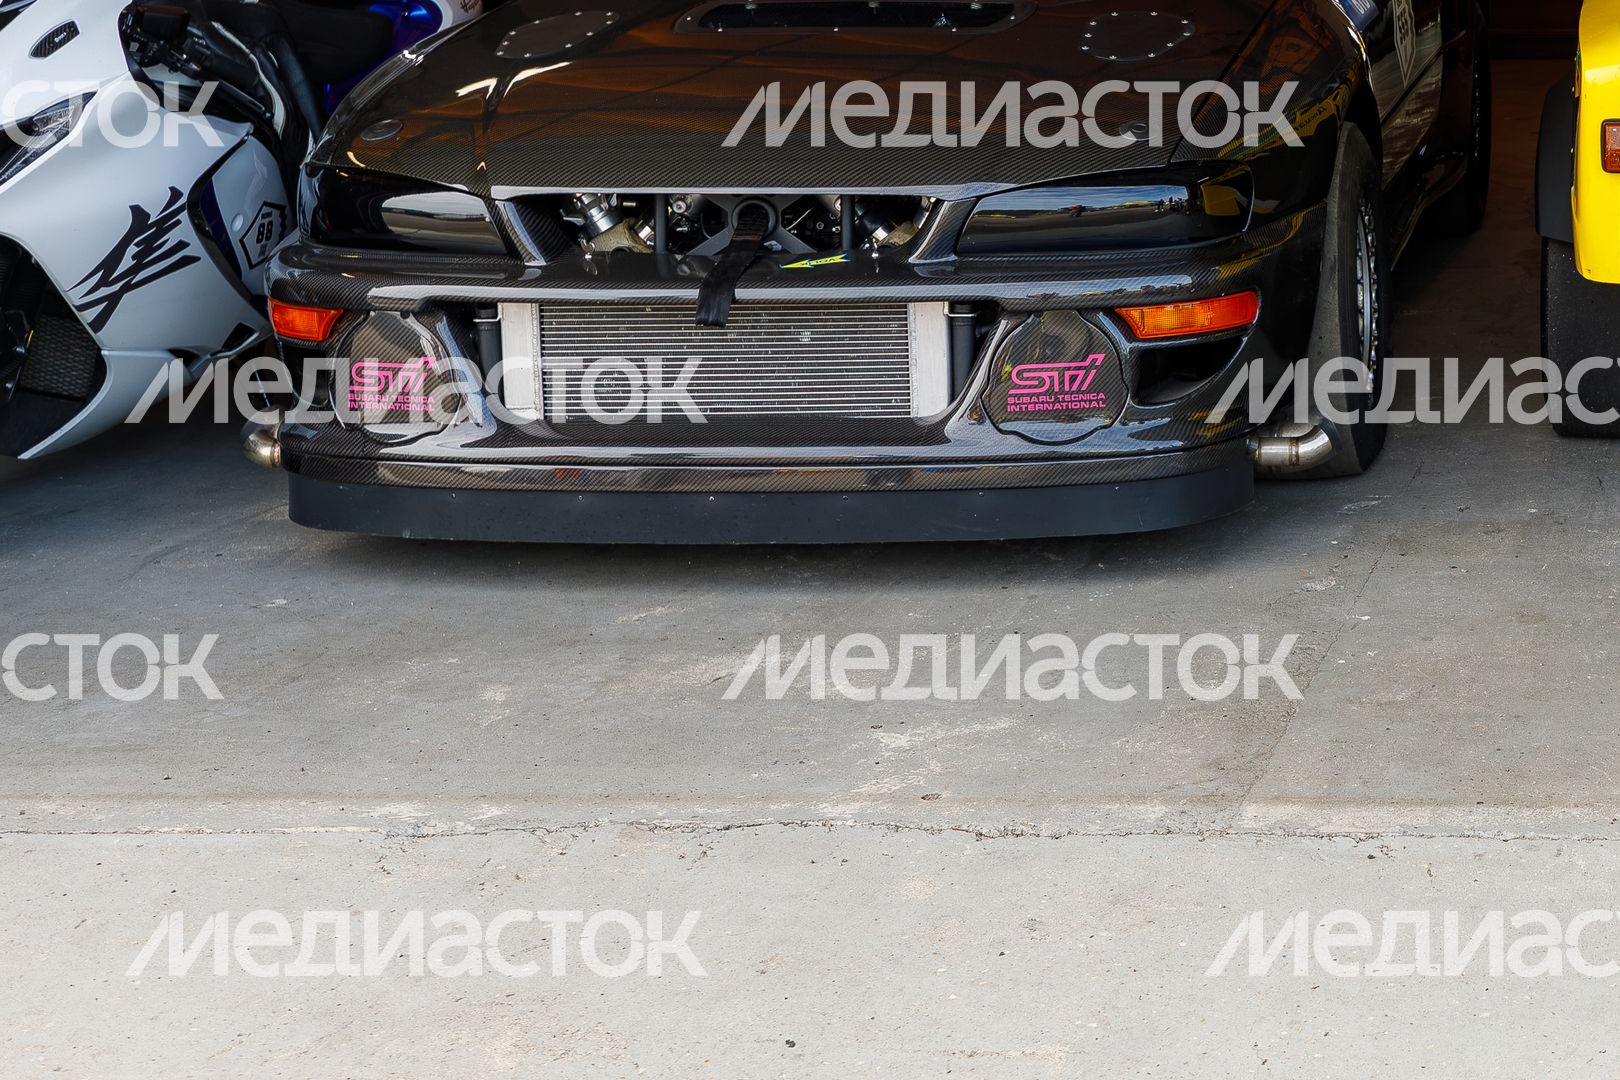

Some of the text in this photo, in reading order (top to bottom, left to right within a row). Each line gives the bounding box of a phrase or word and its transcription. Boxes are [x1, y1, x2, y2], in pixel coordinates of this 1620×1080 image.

[1007, 393, 1106, 404] SUBARU TECNICA
[348, 401, 435, 411] INTERNATIONAL
[1007, 401, 1106, 412] INTERNATIONAL
